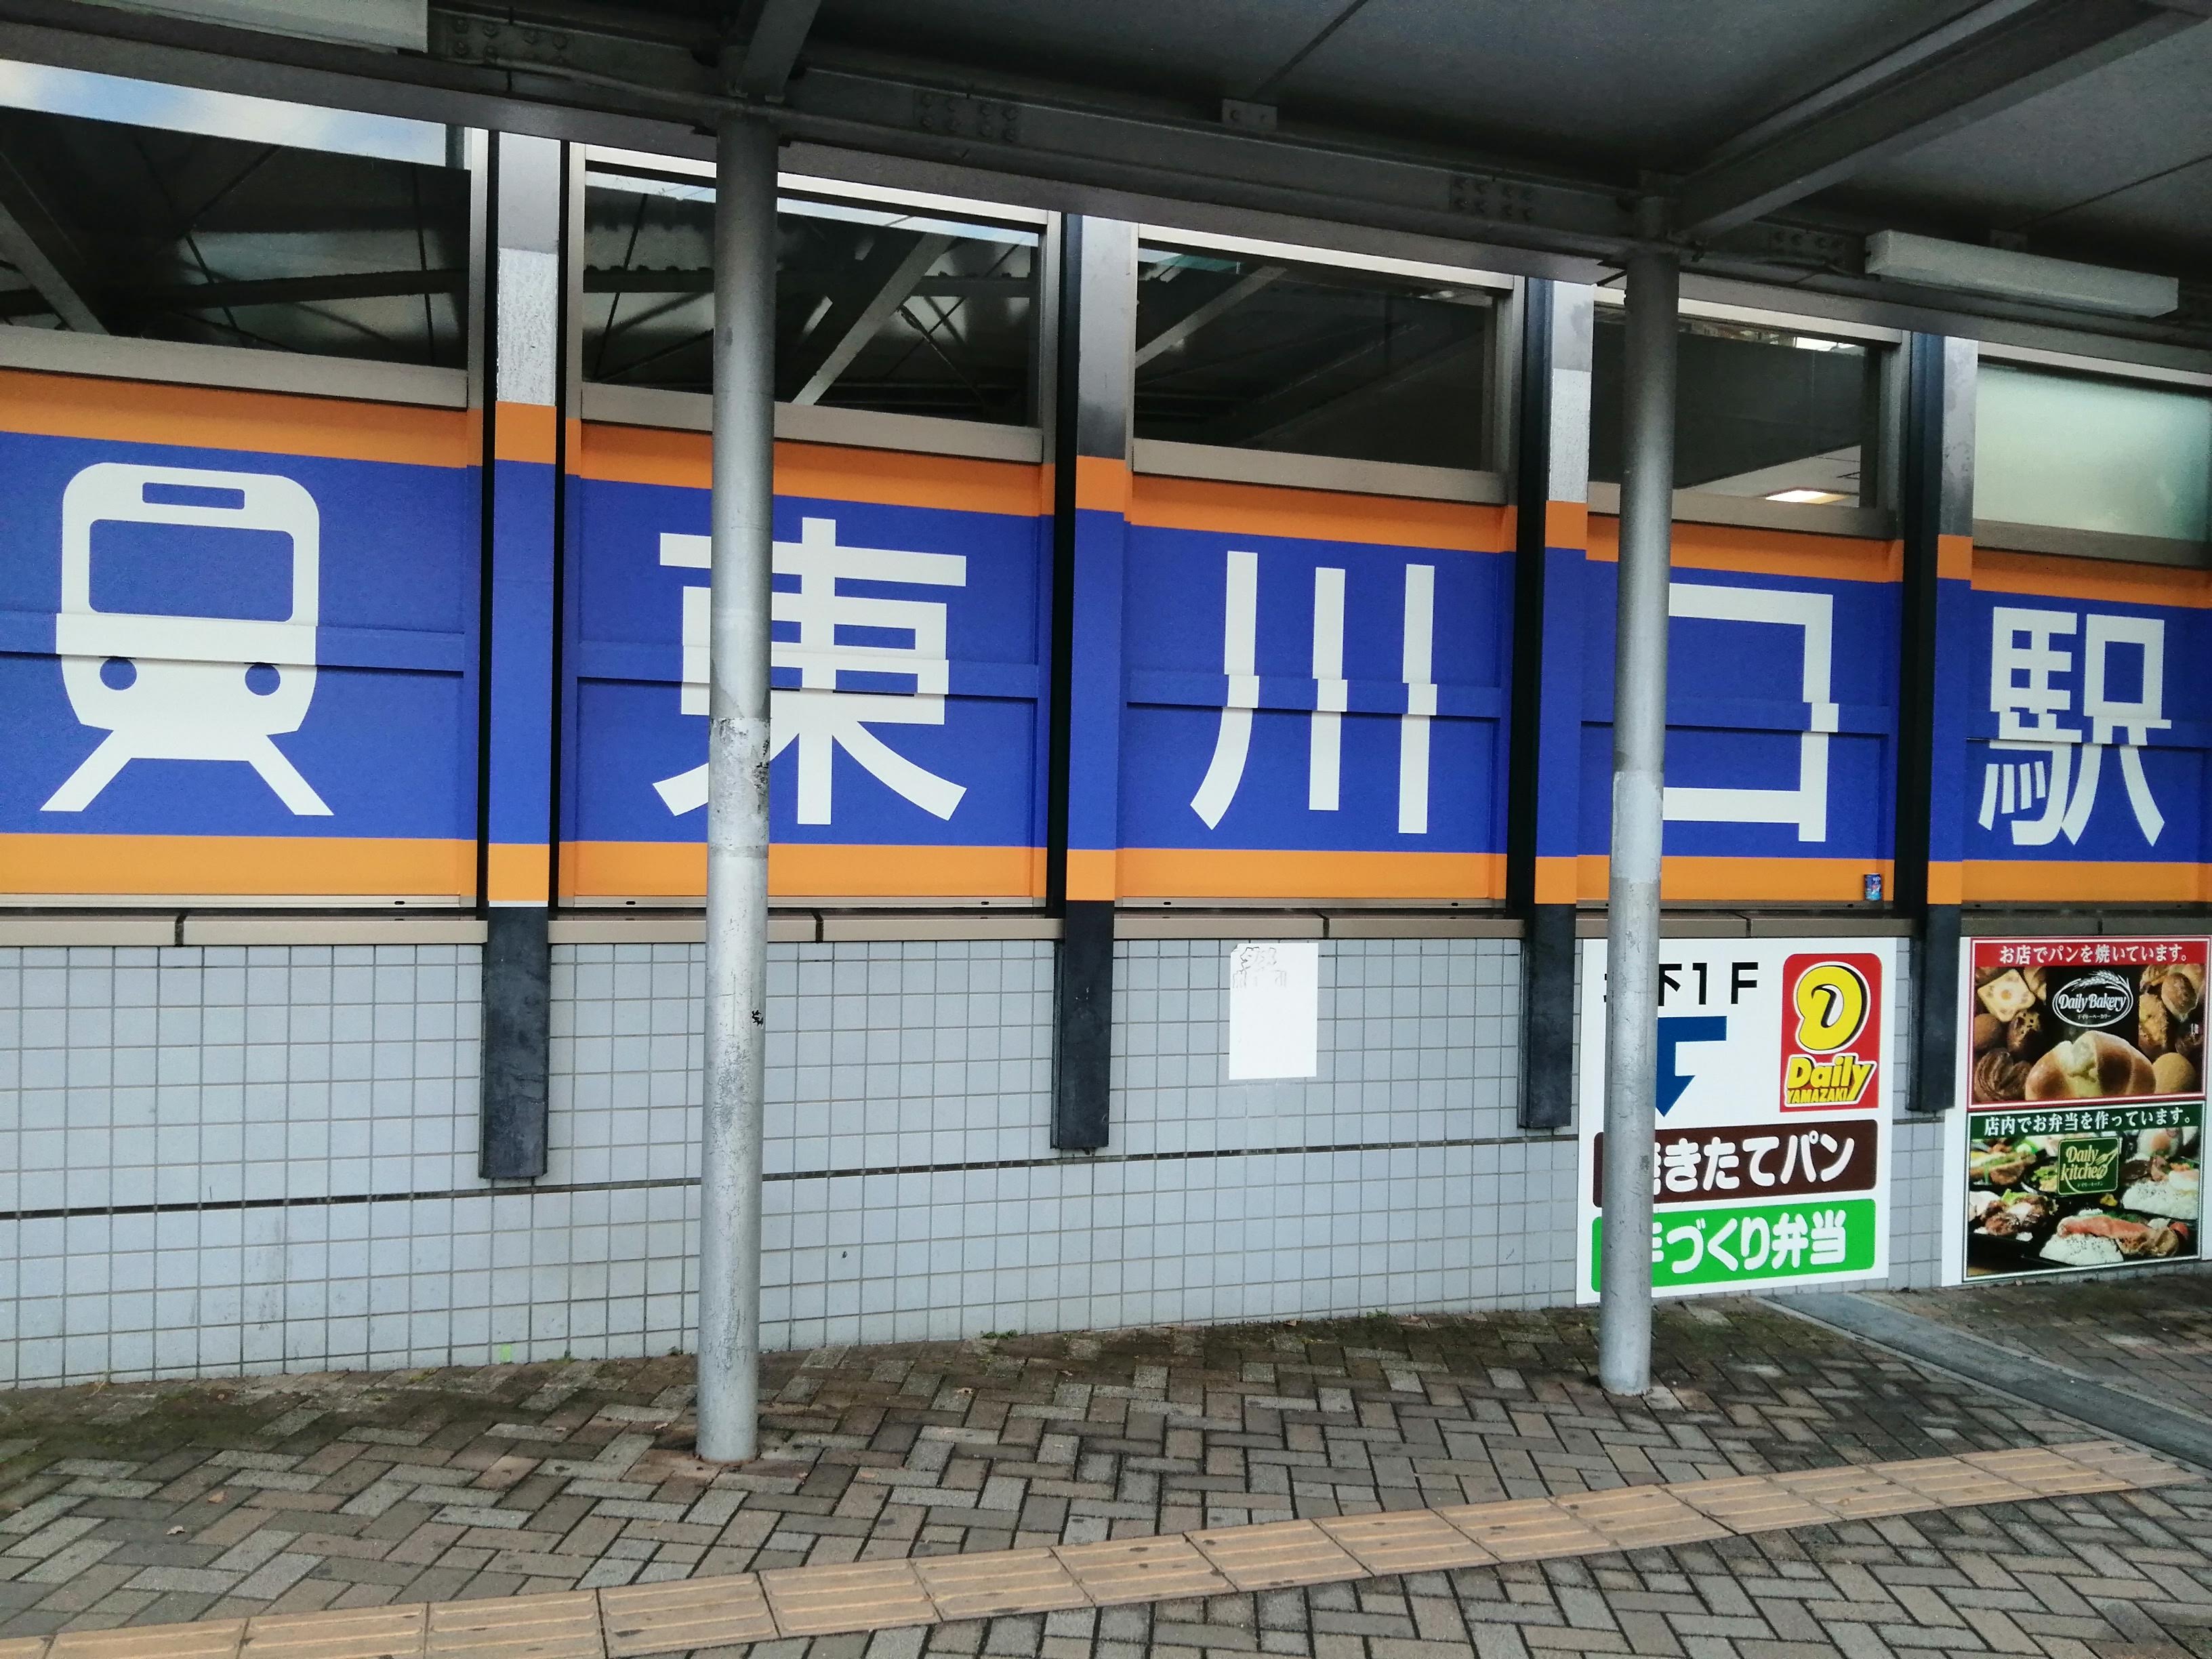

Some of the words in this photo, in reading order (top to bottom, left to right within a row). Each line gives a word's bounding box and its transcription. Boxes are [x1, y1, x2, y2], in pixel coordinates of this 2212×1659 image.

[653, 517, 2171, 848] 東川口駅
[1999, 943, 2188, 965] お店でパンを焼いています。
[1603, 962, 1759, 1006] 下1F
[2058, 993, 2088, 1013] Daily
[2088, 992, 2127, 1012] Bakery
[1786, 1055, 1873, 1101] Daily
[1786, 1086, 1849, 1105] YAMAZAKI
[1984, 1107, 2191, 1136] 店内でお弁当を作っています。
[2066, 1145, 2099, 1166] Daily
